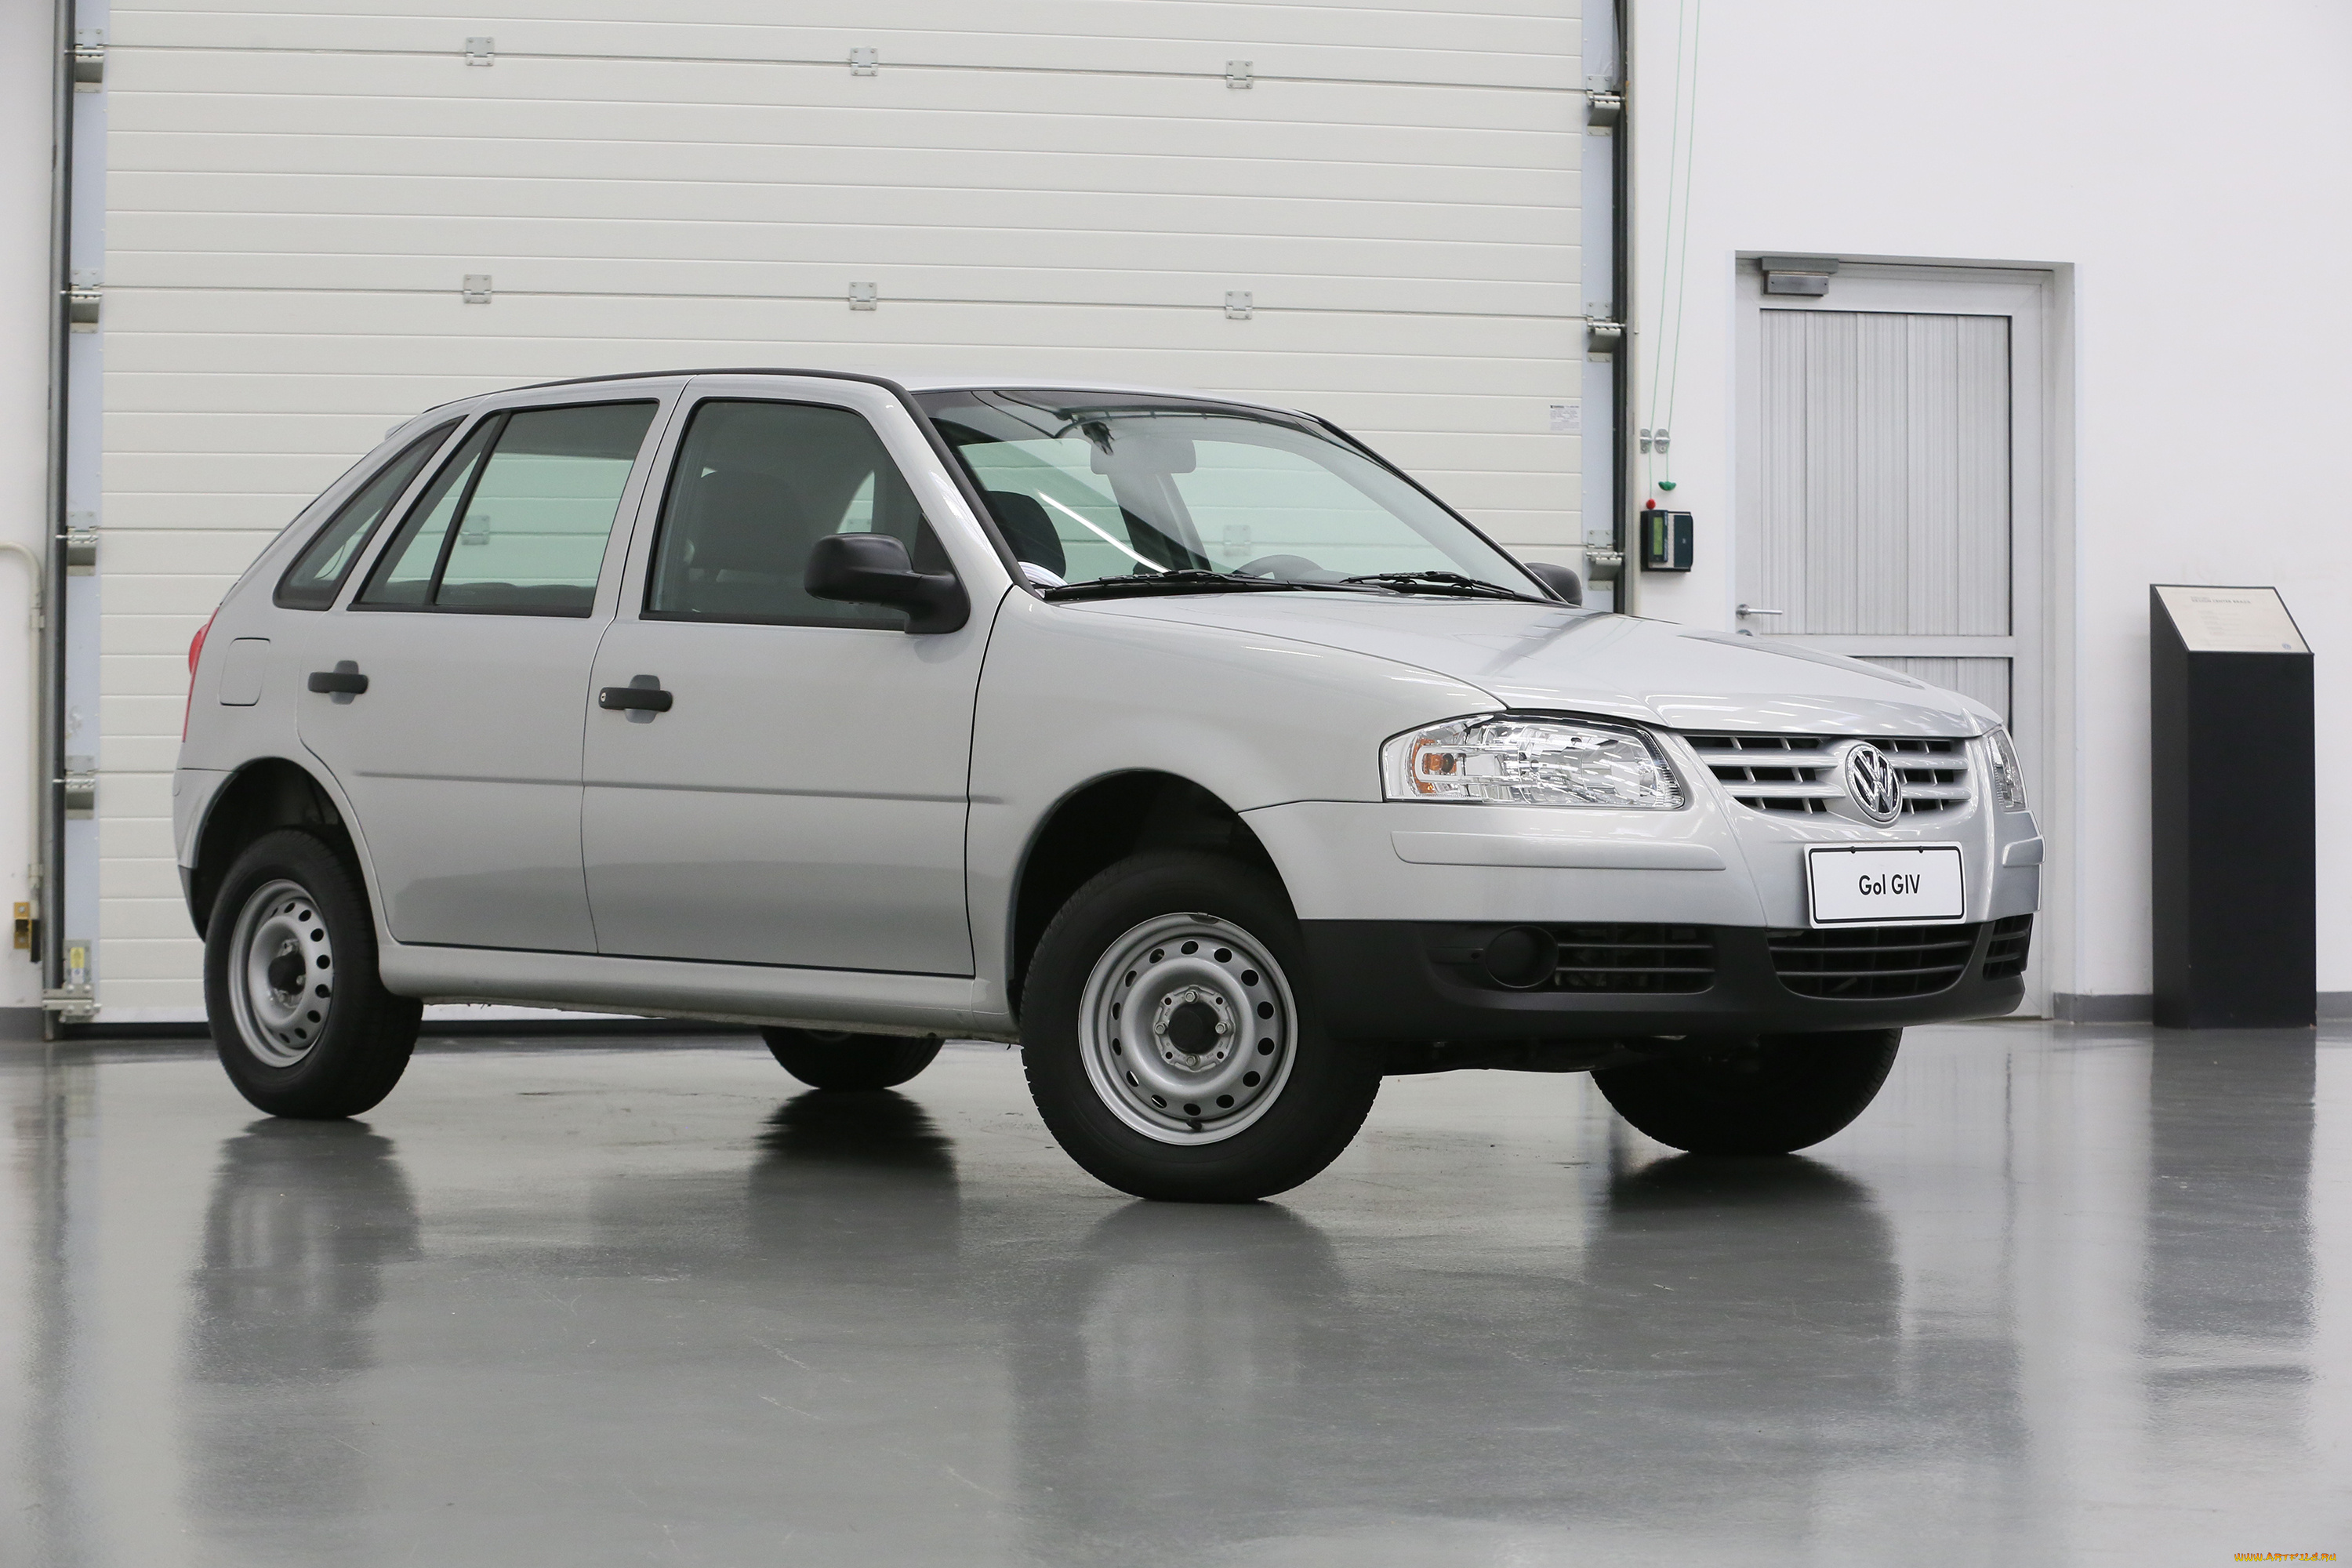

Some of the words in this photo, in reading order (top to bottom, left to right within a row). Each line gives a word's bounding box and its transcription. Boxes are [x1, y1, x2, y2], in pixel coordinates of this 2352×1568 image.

[1851, 747, 1897, 817] VW
[1859, 873, 1886, 895] Gol
[1891, 873, 1921, 895] GIV
